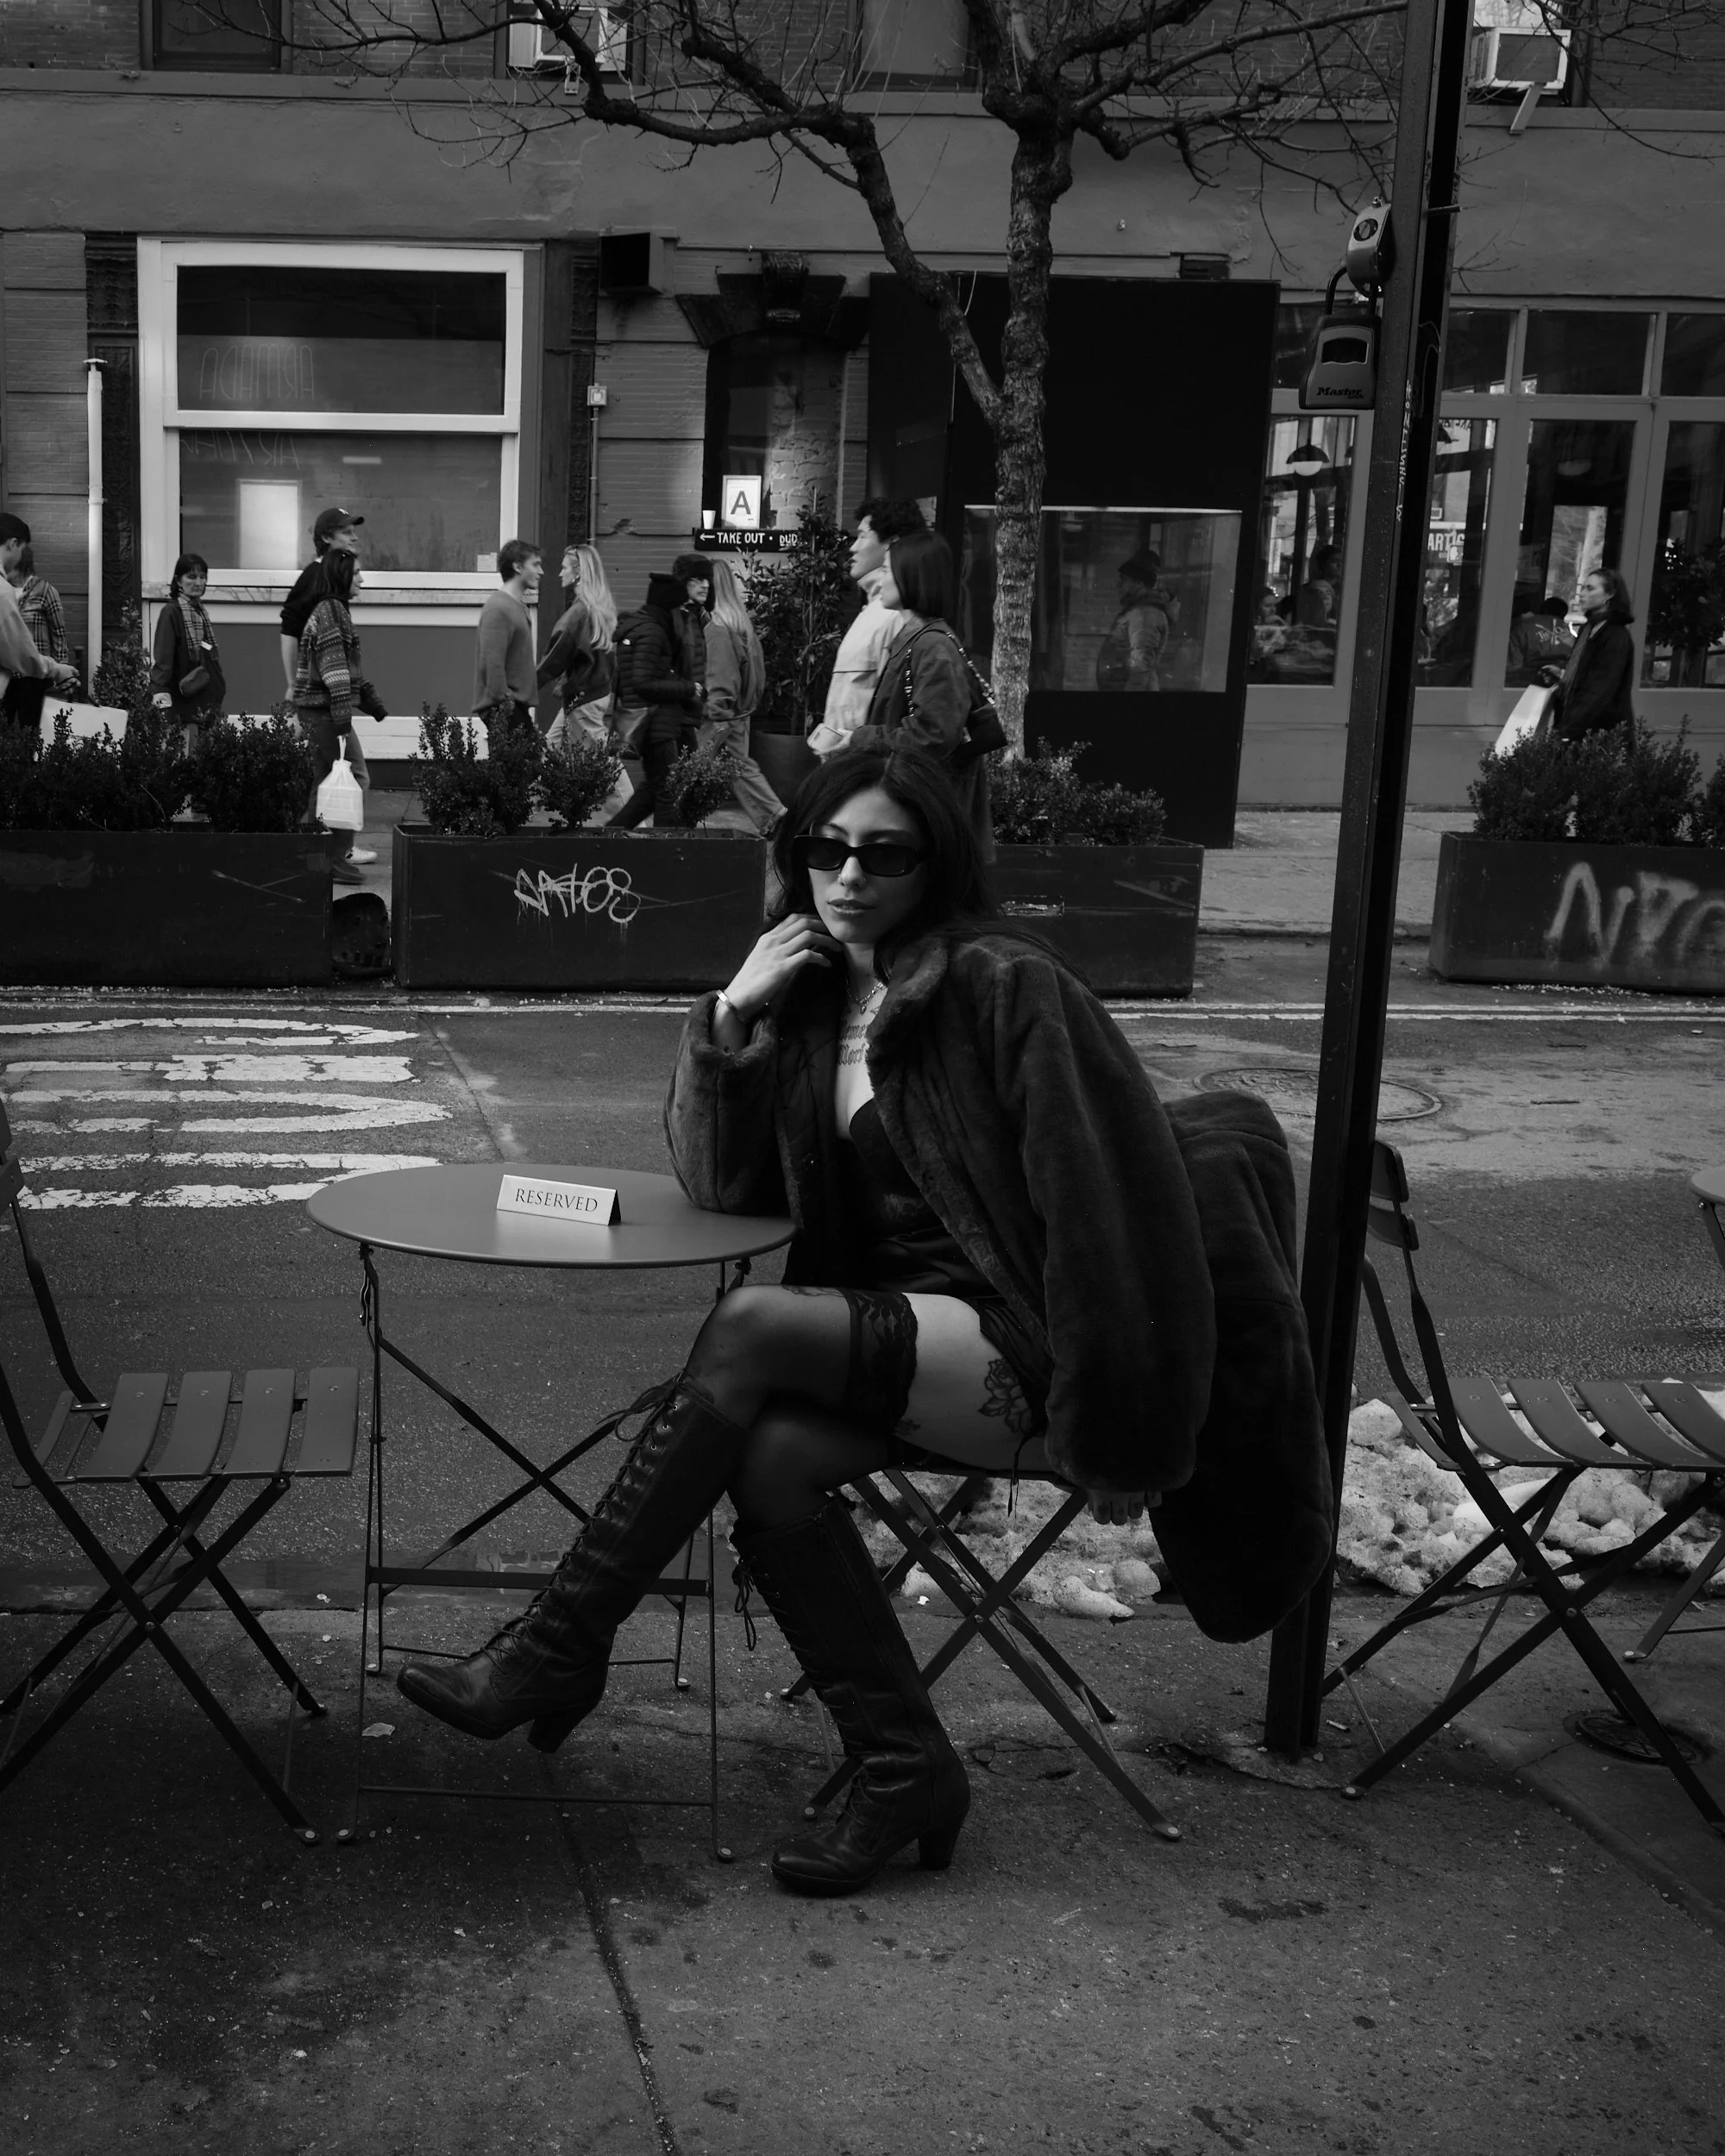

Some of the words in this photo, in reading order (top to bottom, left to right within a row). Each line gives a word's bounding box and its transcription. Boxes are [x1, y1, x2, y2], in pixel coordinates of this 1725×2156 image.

[1316, 386, 1363, 396] Master
[730, 490, 751, 515] A
[717, 531, 742, 544] TAKE
[744, 531, 766, 544] OUT
[515, 1188, 598, 1213] RESERVED
